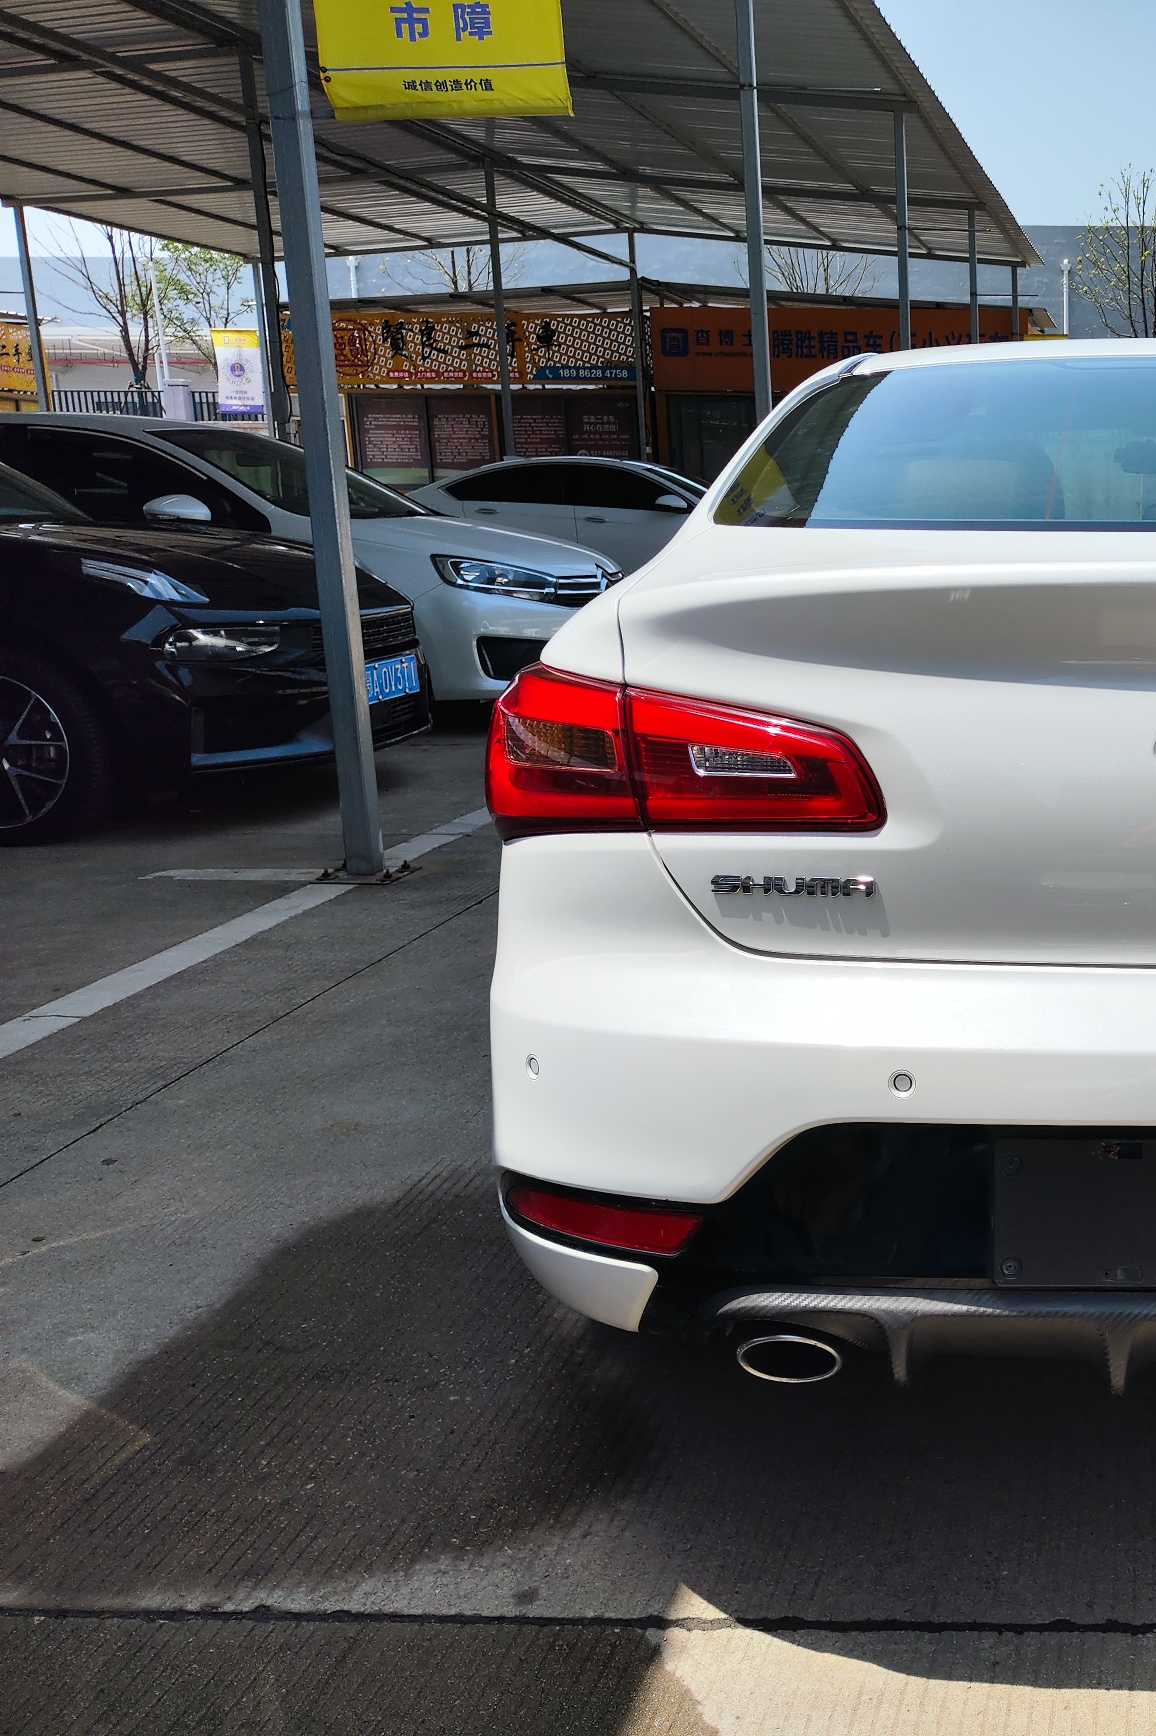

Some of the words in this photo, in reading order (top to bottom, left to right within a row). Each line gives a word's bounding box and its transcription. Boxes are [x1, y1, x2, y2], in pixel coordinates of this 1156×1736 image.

[389, 1, 431, 42] 市
[452, 1, 493, 42] 障
[403, 78, 494, 92] 诚信创造价值
[559, 370, 577, 378] 189
[579, 370, 603, 378] 8628
[604, 370, 628, 378] 4758
[711, 874, 877, 898] SHUMA
